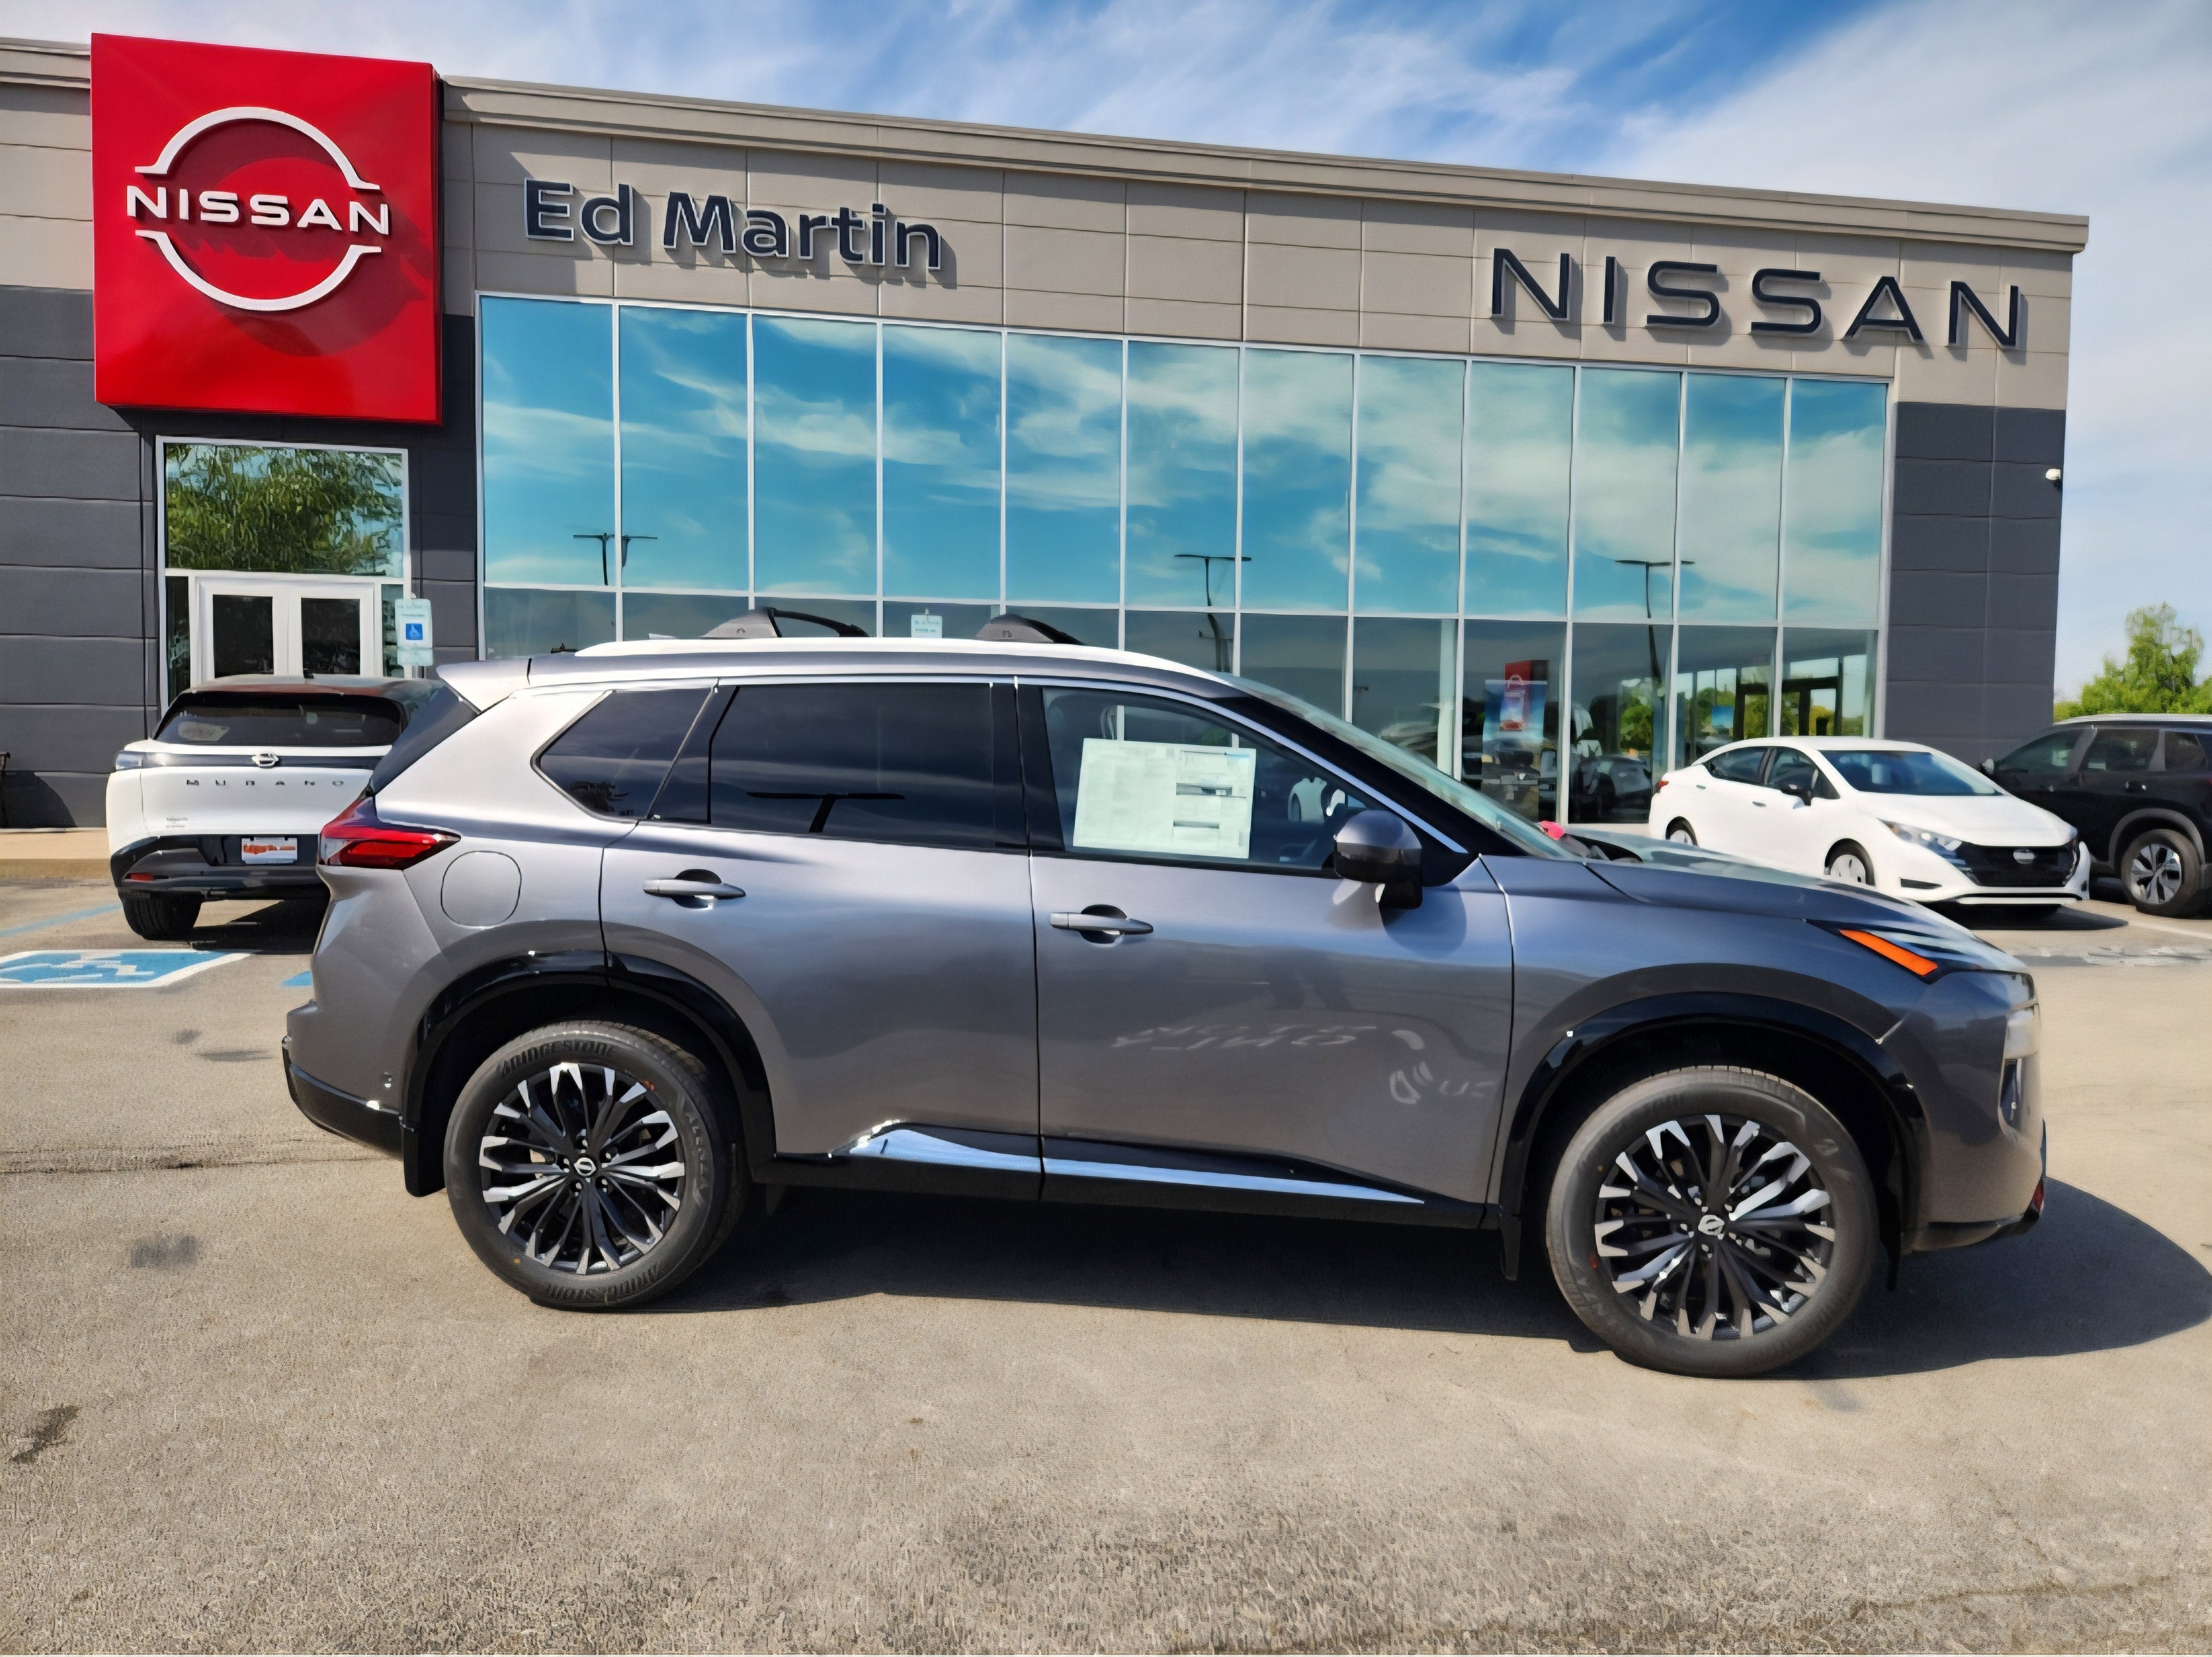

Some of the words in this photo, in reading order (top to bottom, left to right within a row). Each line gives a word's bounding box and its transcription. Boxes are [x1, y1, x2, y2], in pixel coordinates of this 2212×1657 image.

[126, 185, 389, 235] NISSAN
[524, 177, 634, 246] Ed
[664, 191, 942, 270] Martin
[1491, 248, 2020, 348] NISSAN
